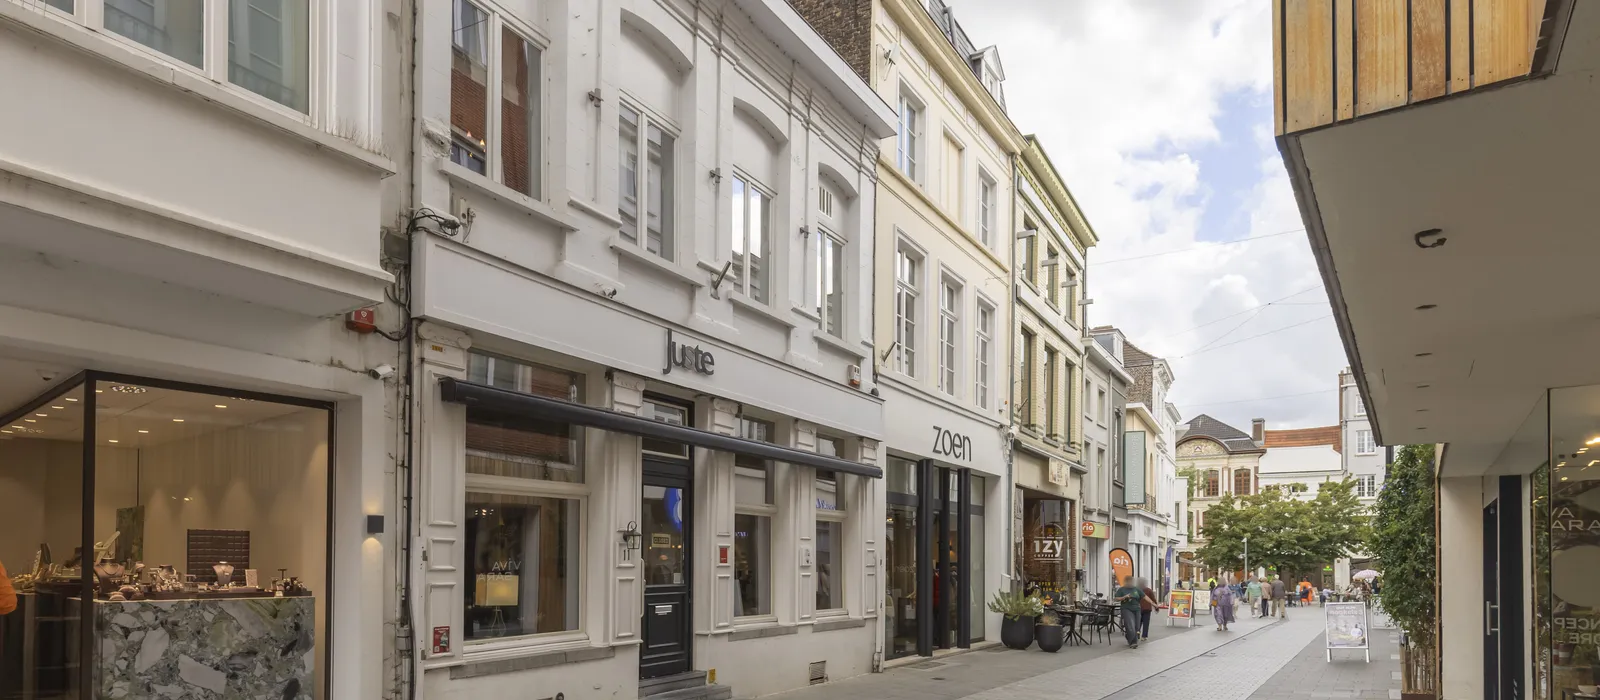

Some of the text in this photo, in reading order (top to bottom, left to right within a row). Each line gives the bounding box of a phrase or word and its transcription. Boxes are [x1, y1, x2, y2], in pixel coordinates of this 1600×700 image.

[663, 328, 715, 376] Juste
[933, 425, 972, 462] zoen
[623, 549, 630, 561] 11
